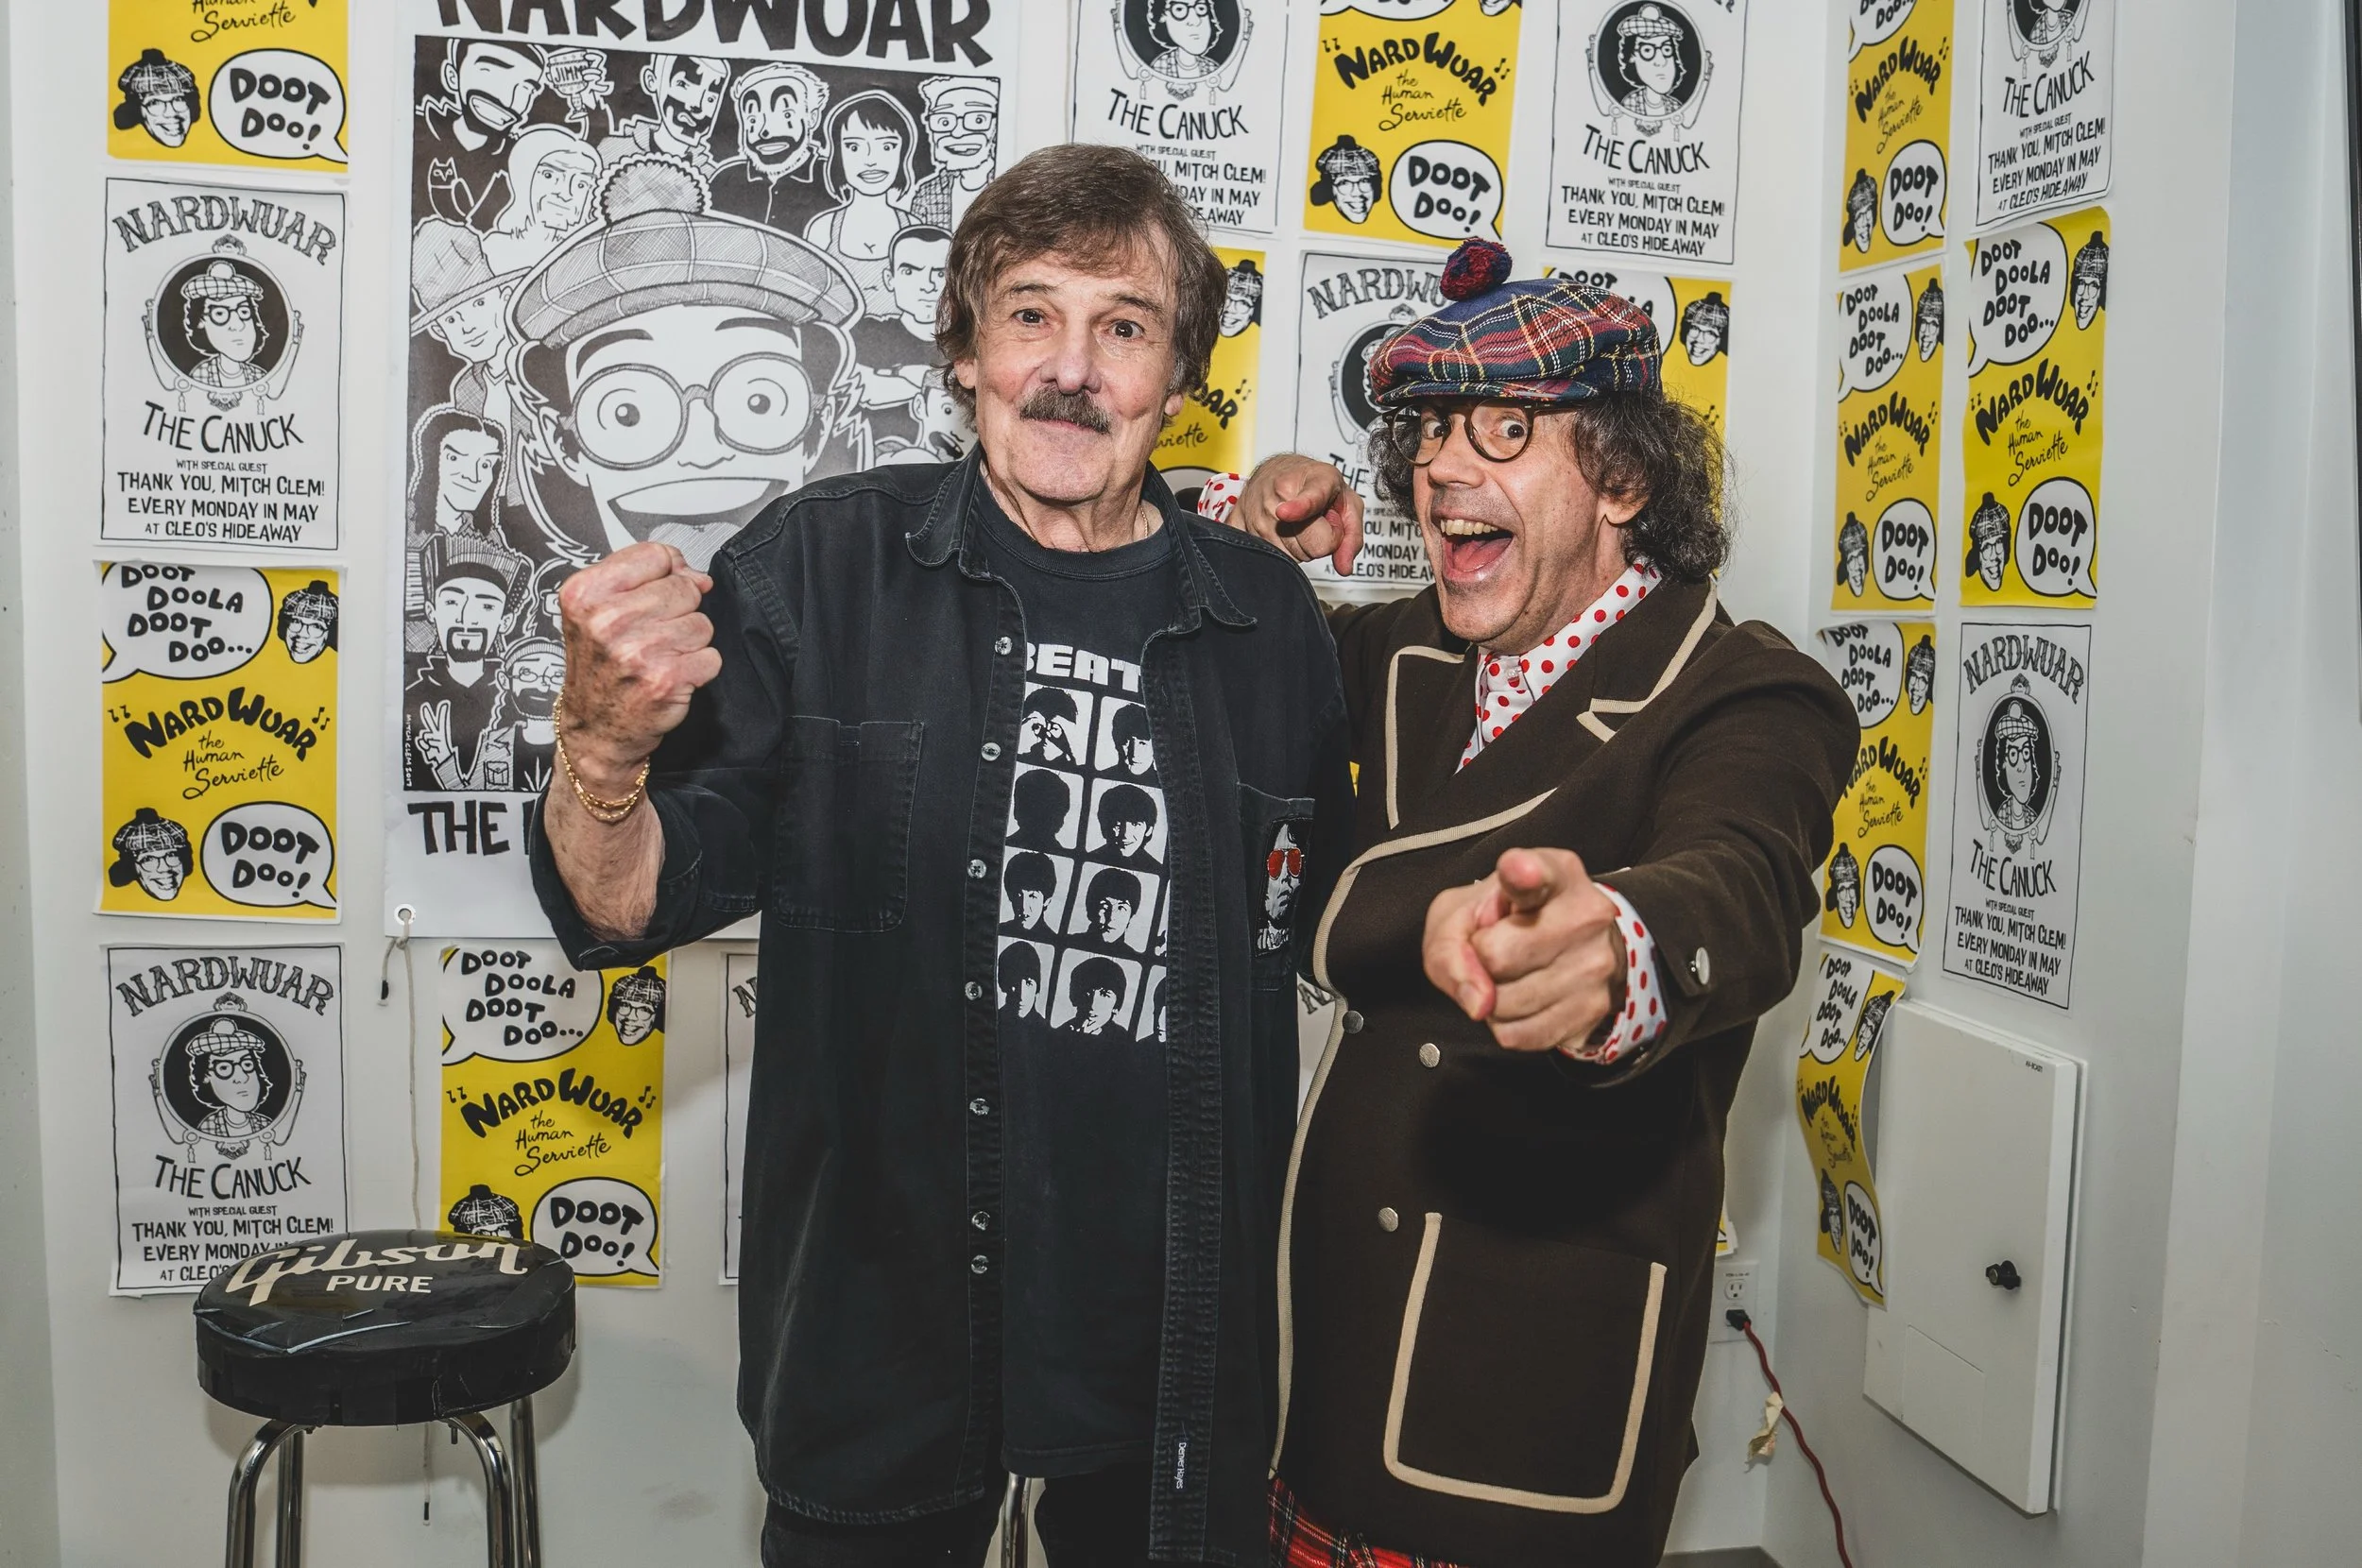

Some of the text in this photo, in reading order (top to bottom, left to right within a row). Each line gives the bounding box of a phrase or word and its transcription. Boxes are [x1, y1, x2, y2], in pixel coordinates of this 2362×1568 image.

[230, 68, 331, 115] DOOT
[1396, 69, 1418, 86] the
[2003, 51, 2095, 118] THE CANUCK
[1382, 86, 1433, 105] Human
[242, 108, 321, 150] DOO!
[1108, 88, 1249, 141] THE CANUCK
[1378, 97, 1466, 131] Serviette
[1583, 124, 1710, 174] THE CANUCK
[1988, 117, 2106, 174] THANK YOU, MITCH CLEM!
[1175, 162, 1218, 181] MITCH
[1224, 162, 1266, 183] CLEM!
[1409, 156, 1491, 201] DOOT
[1891, 165, 1939, 200] DOOT
[1994, 145, 2101, 194] EVERY MONDAY IN MAY
[1212, 188, 1224, 204] IN
[1229, 189, 1260, 207] MAY
[1414, 191, 1481, 232] DOO!
[1562, 186, 1724, 216] THANK YOU, MITCH CLEM!
[1997, 198, 2008, 211] AT
[2010, 187, 2038, 210] CLEO'S
[112, 196, 335, 265] NARDWUAR
[1568, 209, 1719, 239] EVERY MONDAY IN MAY
[1893, 202, 1933, 231] DOO!
[1582, 233, 1592, 243] AT
[1597, 231, 1638, 248] CLEO'S
[1981, 239, 2022, 277] DOOT
[1307, 268, 1448, 319] NARDWU
[1995, 260, 2050, 297] DOOLA
[1846, 283, 1878, 316] DOOT
[1983, 293, 2031, 326] DOOT
[1858, 302, 1899, 332] DOOLA
[1850, 331, 1886, 359] DOOT
[144, 401, 304, 453] THE CANUCK
[2015, 409, 2030, 431] the
[2008, 430, 2044, 458] Human
[2008, 431, 2068, 486] Serviette
[177, 459, 267, 474] WITH SPECIAL GUEST
[1866, 453, 1914, 502] Serviette
[1868, 453, 1895, 474] Human
[117, 472, 324, 497] THANK YOU, MITCH CLEM!
[128, 497, 318, 522] EVERY MONDAY IN MAY
[145, 523, 160, 535] AT
[166, 521, 216, 537] CLEO'S
[1882, 520, 1929, 558] DOOT
[2029, 503, 2088, 547] DOOT
[1364, 544, 1419, 562] MONDAY
[2032, 543, 2080, 586] DOO!
[121, 564, 195, 588] DOOT
[1885, 554, 1924, 591] DOO!
[147, 586, 243, 613] DOOLA
[128, 612, 212, 639] DOOT
[1828, 624, 1869, 647] DOOT
[1027, 642, 1141, 693] EAT
[1849, 644, 1891, 668] DOOLA
[1963, 635, 2084, 705] NARDWUAR
[1842, 667, 1875, 691] DOOT
[198, 730, 224, 750] the
[183, 750, 244, 771] Human
[182, 755, 284, 800] Serviette
[1859, 794, 1885, 813] Human
[407, 800, 510, 856] THE
[1857, 802, 1904, 838] Serviette
[221, 822, 320, 863] DOOT
[232, 859, 311, 898] DOO!
[1971, 839, 2056, 897] THE CANUCK
[1873, 861, 1917, 908] DOOT
[1876, 897, 1911, 939] DOO!
[1985, 898, 2034, 921] WITH SPECIAL GUEST
[1956, 906, 2066, 950] THANK YOU, MITCH CLEM!
[461, 950, 531, 975] DOOT
[1826, 958, 1852, 980] DOOT
[1958, 931, 2061, 977] EVERY MONDAY IN MAY
[1965, 959, 1973, 971] AT
[1976, 959, 2003, 980] CLEO'S
[116, 956, 334, 1016] NARDWUAR
[485, 973, 575, 998] DOOLA
[1828, 980, 1857, 1009] DOOLA
[466, 998, 545, 1022] DOOT
[1816, 1001, 1841, 1028] DOOT
[531, 1110, 555, 1130] the
[514, 1133, 611, 1176] Serviette
[515, 1130, 574, 1151] Human
[155, 1154, 311, 1200] THE CANUCK
[189, 1205, 278, 1218] WITH SPECIAL GUEST
[550, 1197, 644, 1236] DOOT
[132, 1216, 334, 1242] THANK YOU, MITCH CLEM!
[144, 1244, 199, 1262] EVERY
[560, 1231, 635, 1267] DOO!
[161, 1269, 175, 1281] AT
[225, 1239, 527, 1306] Gibson
[326, 1276, 433, 1294] PURE
